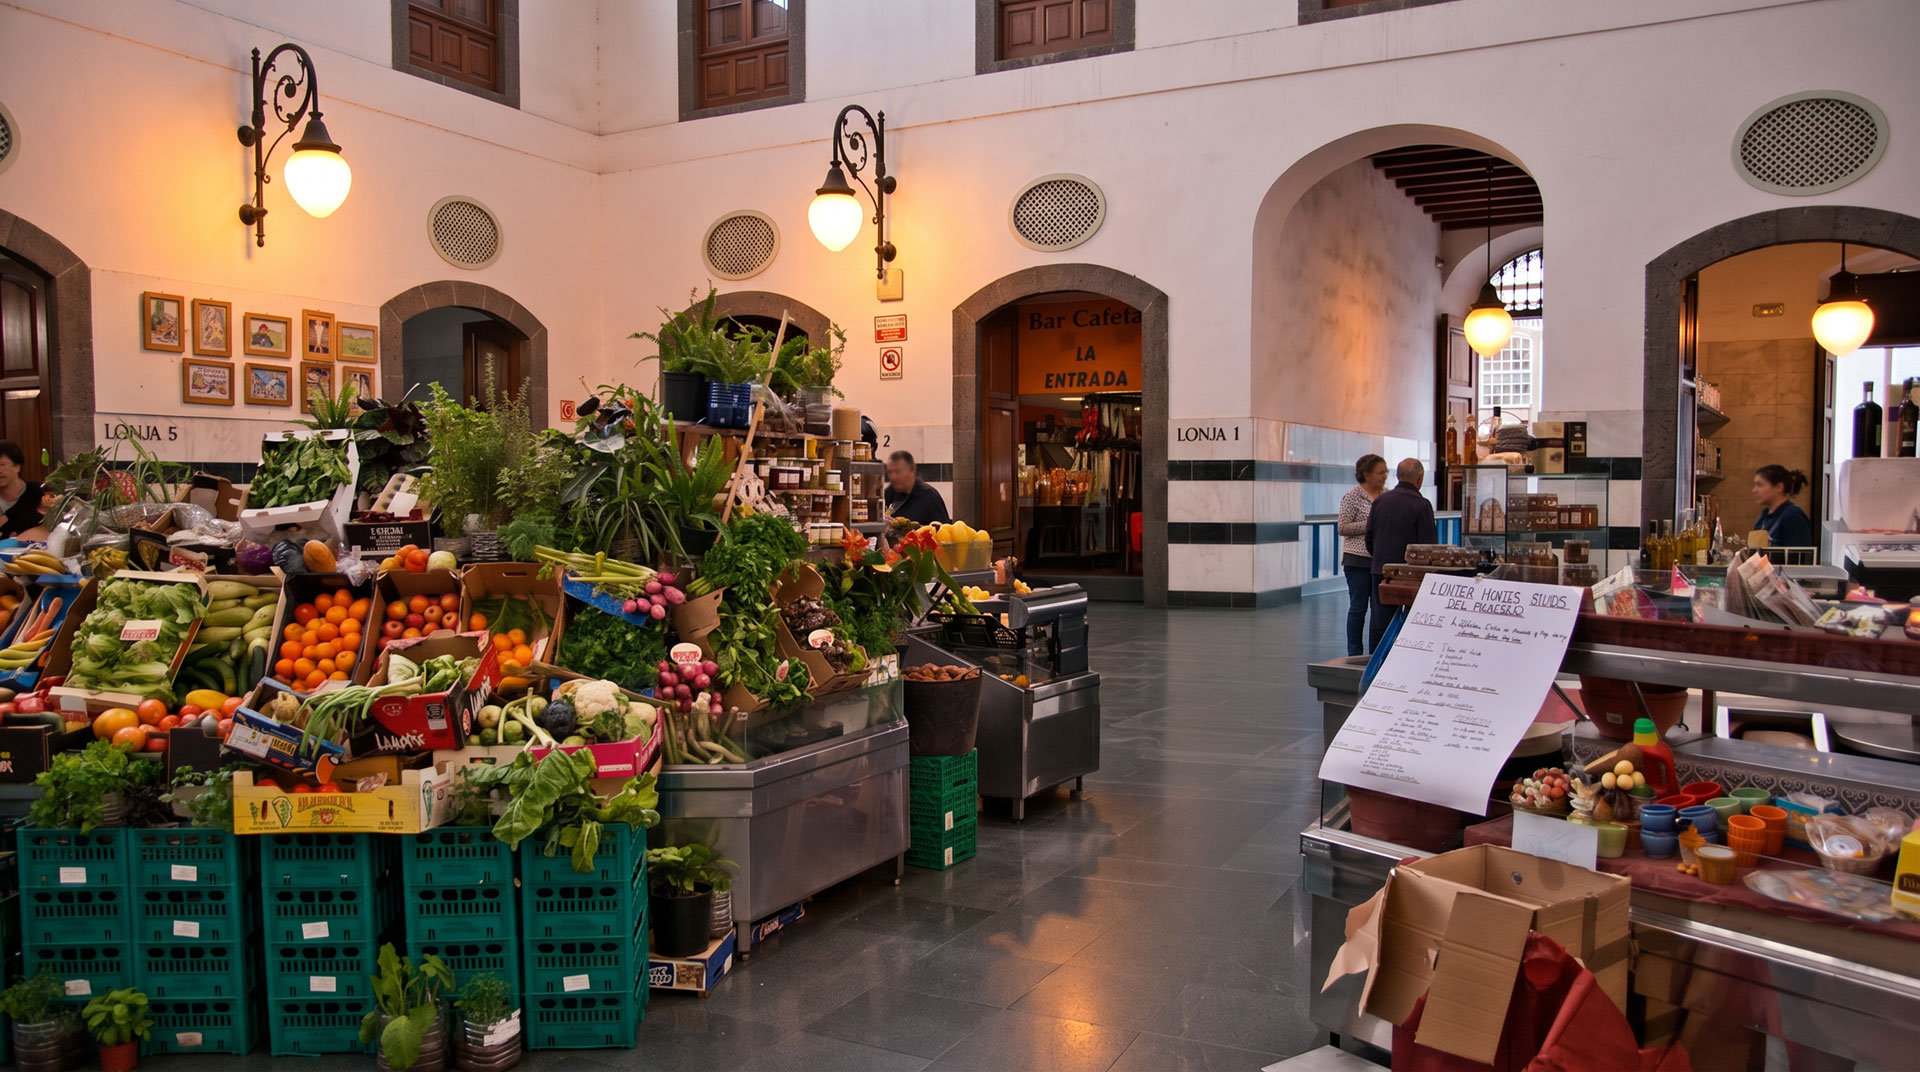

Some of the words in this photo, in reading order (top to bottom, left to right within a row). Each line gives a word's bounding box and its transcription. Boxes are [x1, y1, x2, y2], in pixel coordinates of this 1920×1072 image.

[1029, 312, 1065, 330] Bar
[1076, 345, 1096, 361] LA
[1045, 370, 1128, 389] ENTRADA
[105, 423, 161, 441] LONJA
[168, 426, 178, 441] 5
[1177, 427, 1227, 441] LONJA
[1234, 426, 1239, 441] 1
[883, 434, 890, 447] 2
[1446, 598, 1467, 611] DEL
